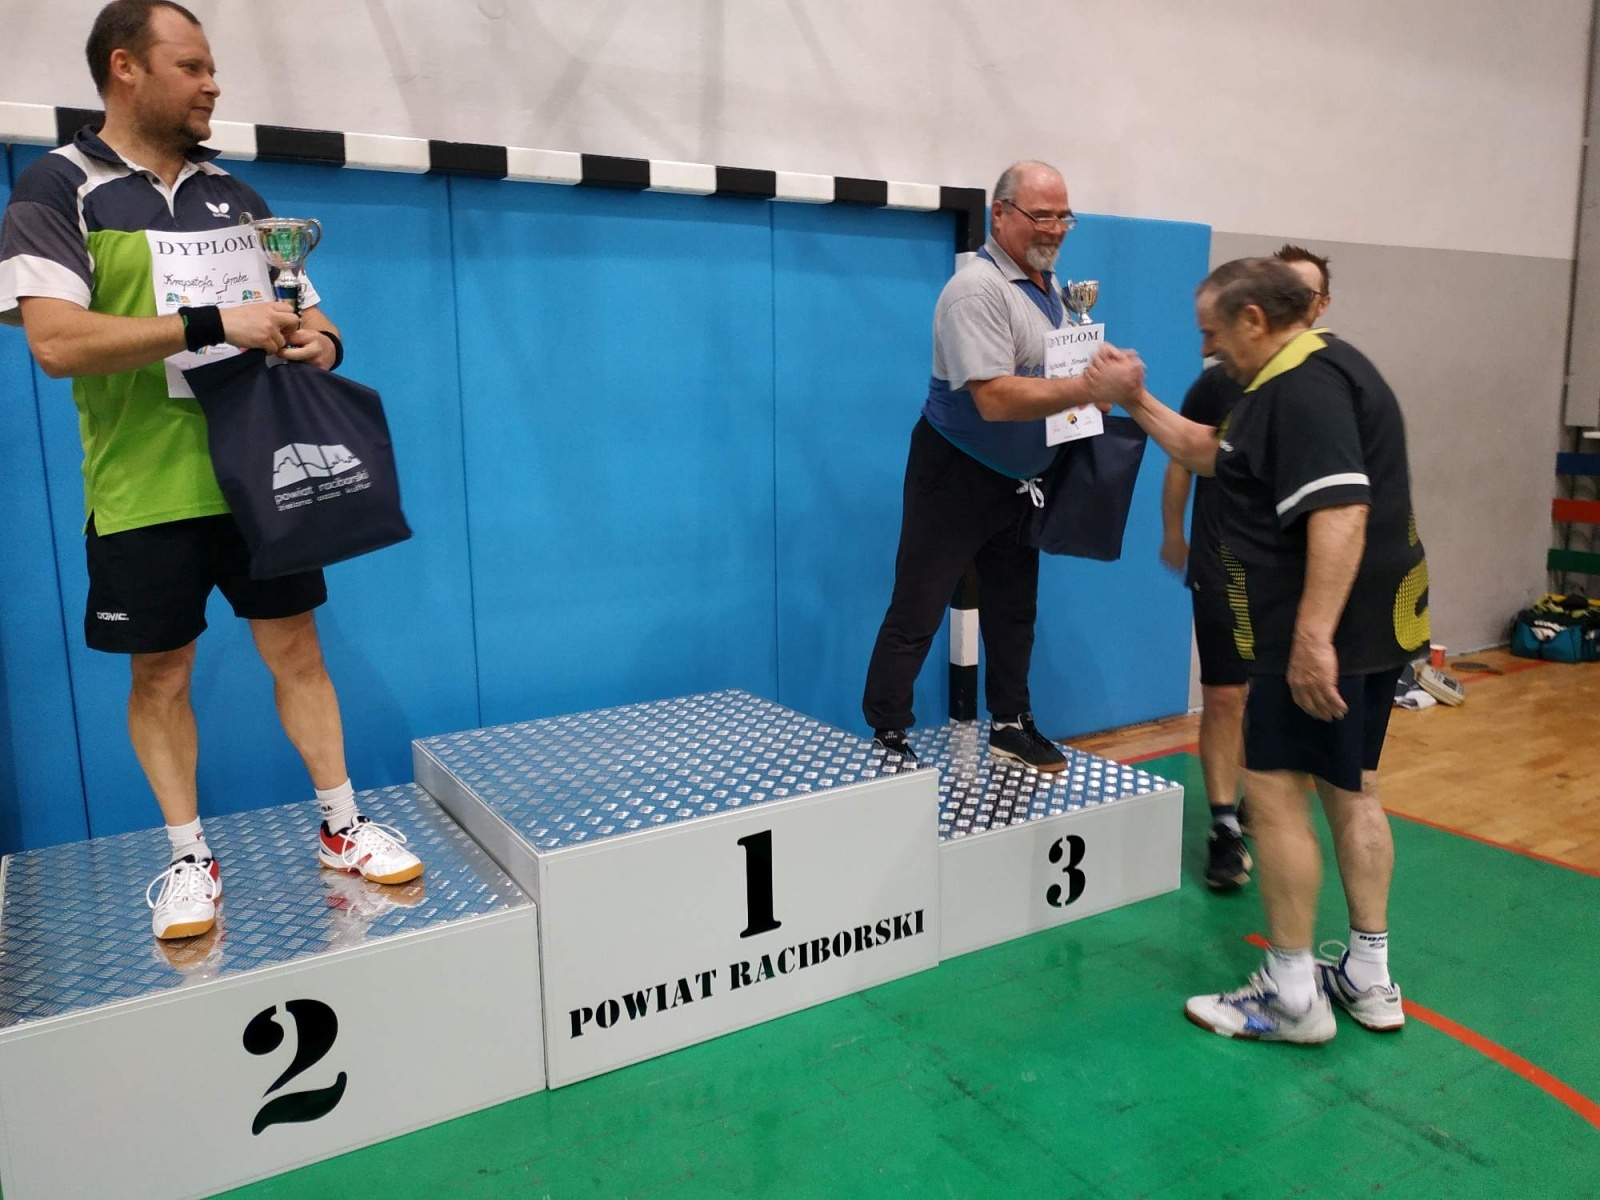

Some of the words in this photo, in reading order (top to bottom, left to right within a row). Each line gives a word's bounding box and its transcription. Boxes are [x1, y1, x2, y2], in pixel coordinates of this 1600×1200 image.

[157, 234, 256, 256] DYPLOM
[1047, 330, 1100, 348] DYPLOM
[274, 486, 315, 505] powiat
[96, 611, 130, 621] DONIC
[737, 829, 782, 939] 1
[1046, 834, 1086, 908] 3
[569, 969, 717, 1039] POWIAT
[729, 909, 924, 991] RACIBORSKI
[242, 998, 347, 1136] 2
